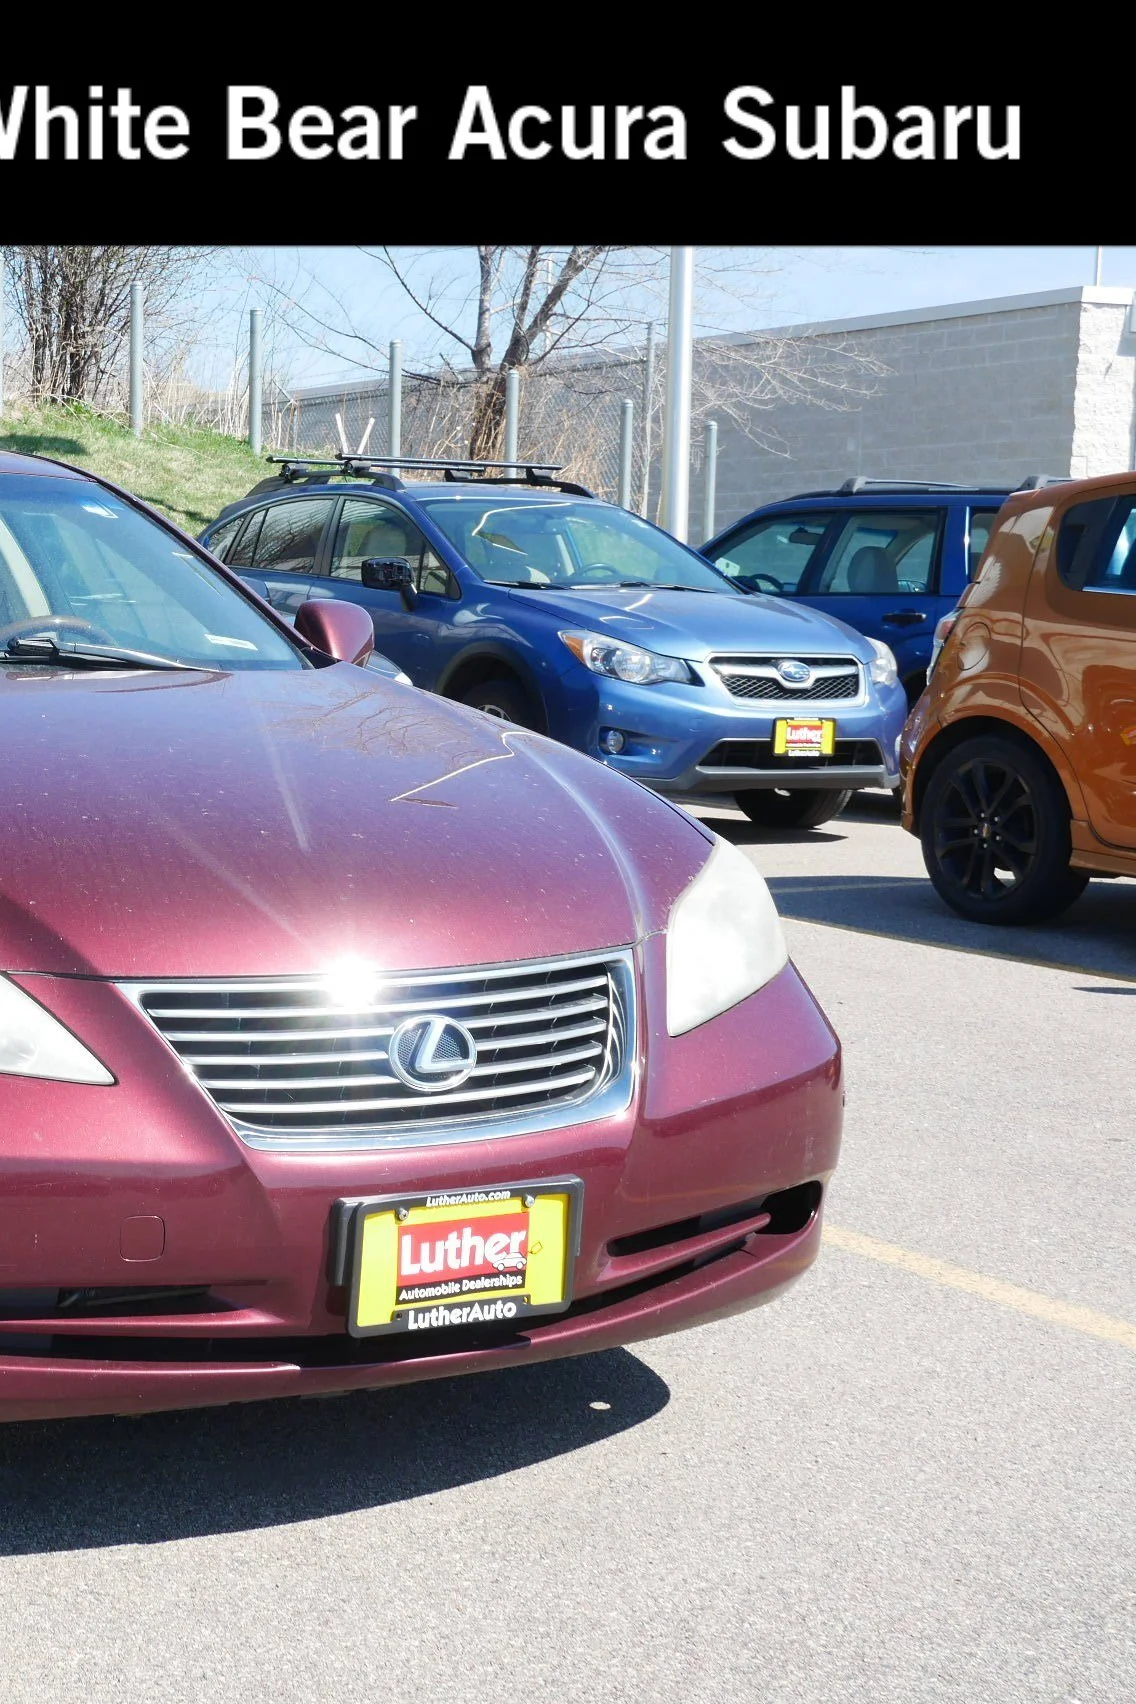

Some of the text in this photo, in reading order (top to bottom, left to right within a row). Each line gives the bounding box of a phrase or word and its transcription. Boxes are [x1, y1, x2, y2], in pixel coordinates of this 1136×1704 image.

[426, 1190, 511, 1207] LutherAuto.com
[401, 1227, 526, 1275] Luther
[399, 1275, 523, 1300] Automobile Dealerships
[408, 1302, 517, 1330] LutherAuto
